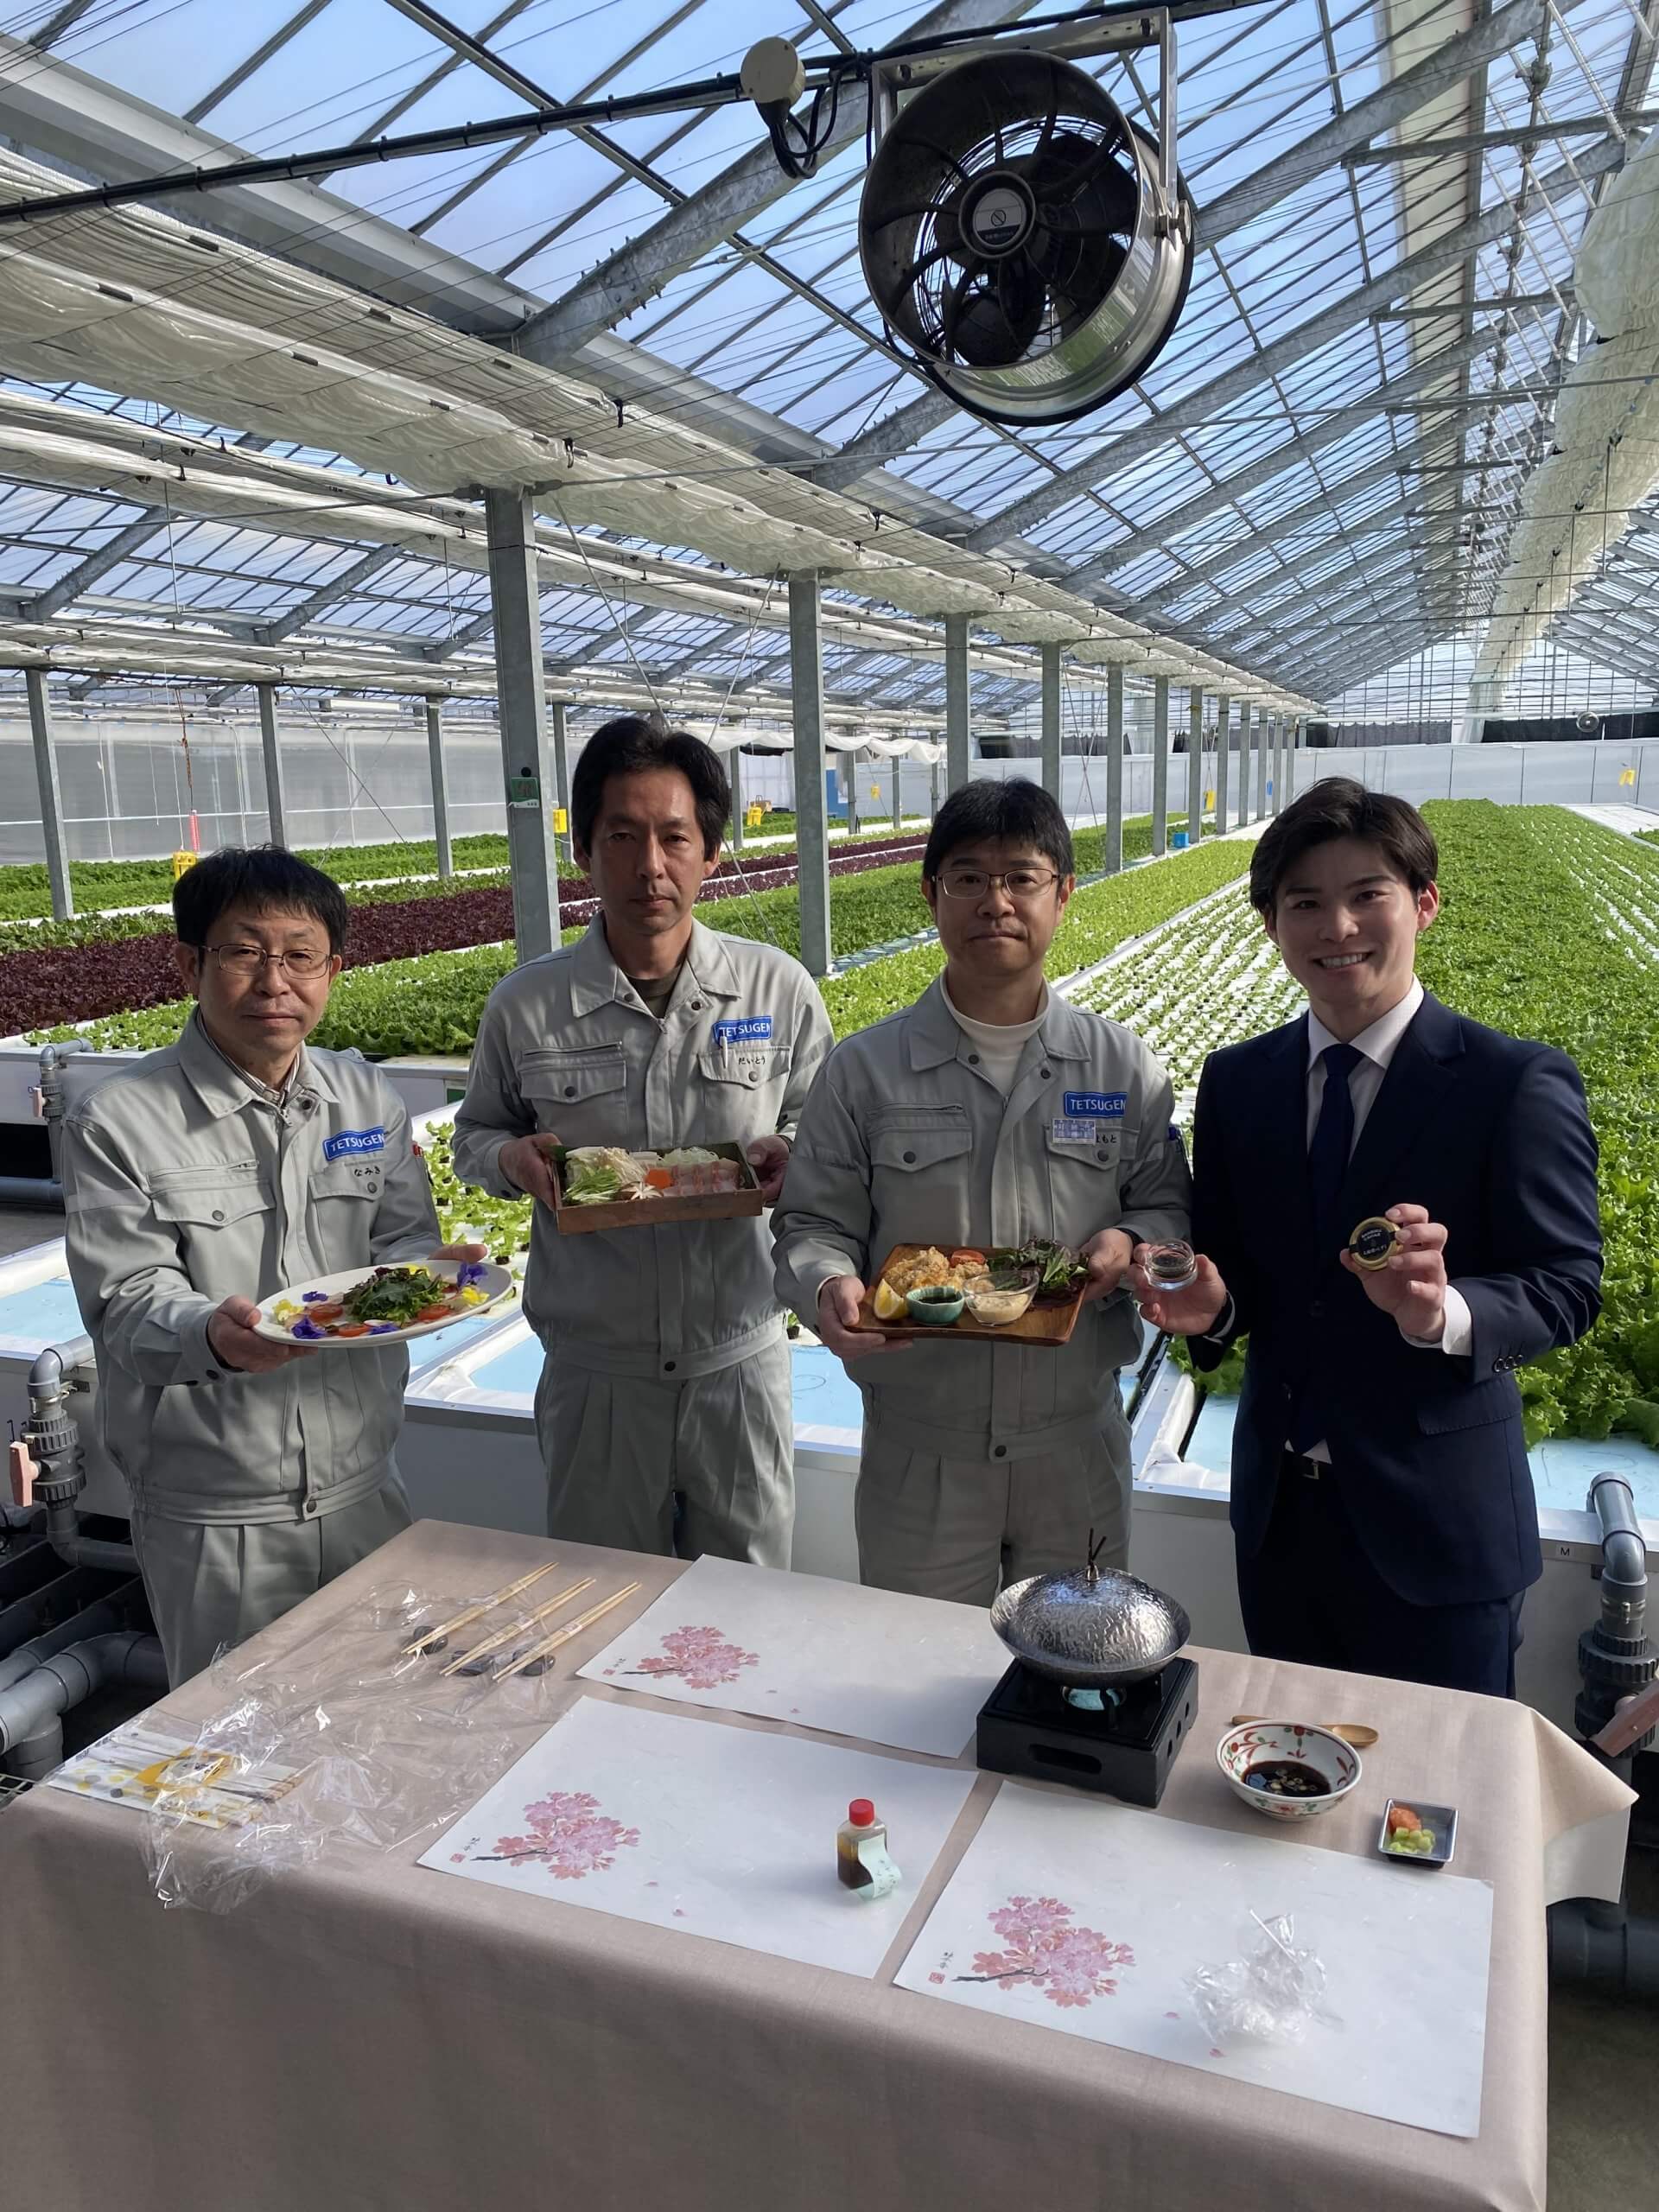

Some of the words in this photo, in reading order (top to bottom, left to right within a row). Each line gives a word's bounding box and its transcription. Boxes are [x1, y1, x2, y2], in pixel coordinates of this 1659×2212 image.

[1071, 1098, 1126, 1110] TETSUGEN
[331, 1133, 384, 1151] TETSUGEN
[1560, 1548, 1570, 1556] M
